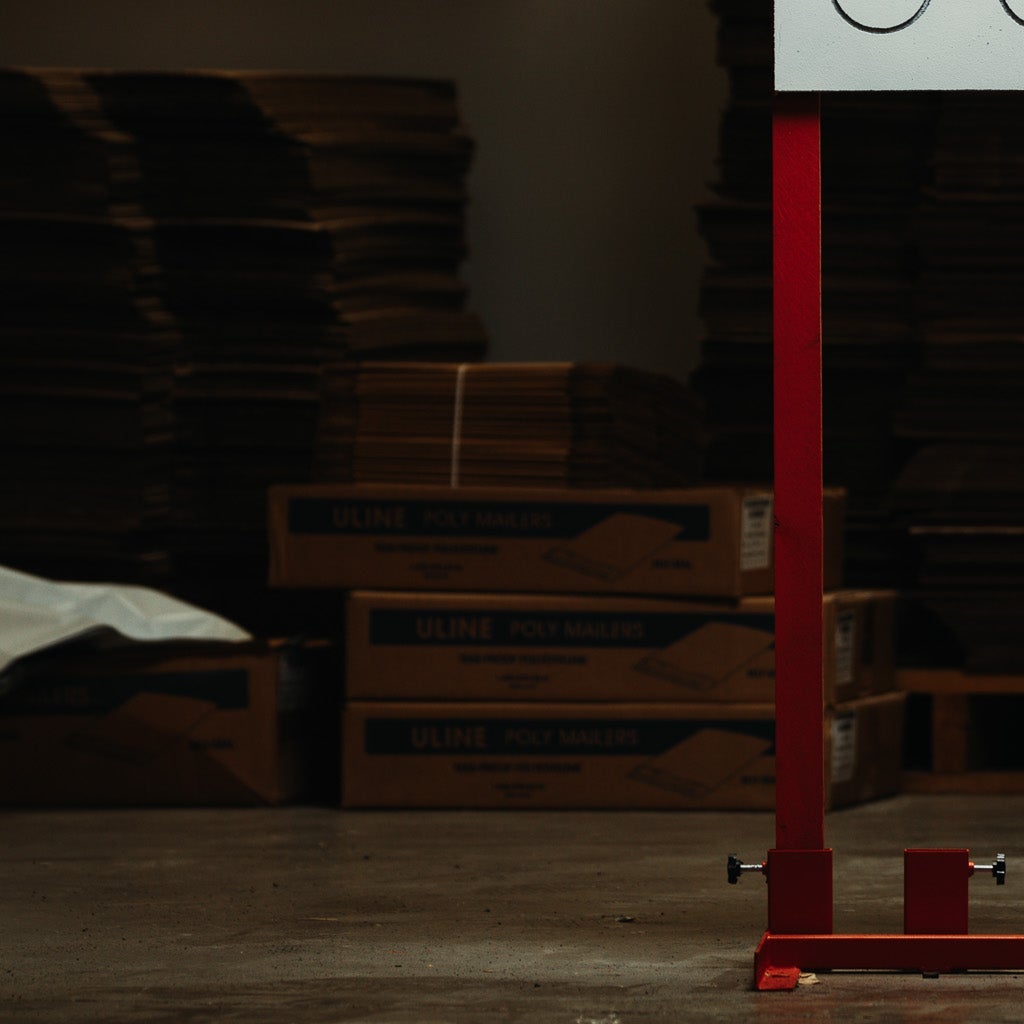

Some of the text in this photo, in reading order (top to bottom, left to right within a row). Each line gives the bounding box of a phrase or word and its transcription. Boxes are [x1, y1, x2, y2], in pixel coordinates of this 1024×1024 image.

[332, 505, 554, 529] ULINE POLY MAILERS
[414, 615, 645, 641] ULINE POLY MAILERS
[410, 725, 639, 749] ULINE POLY MAILERS
